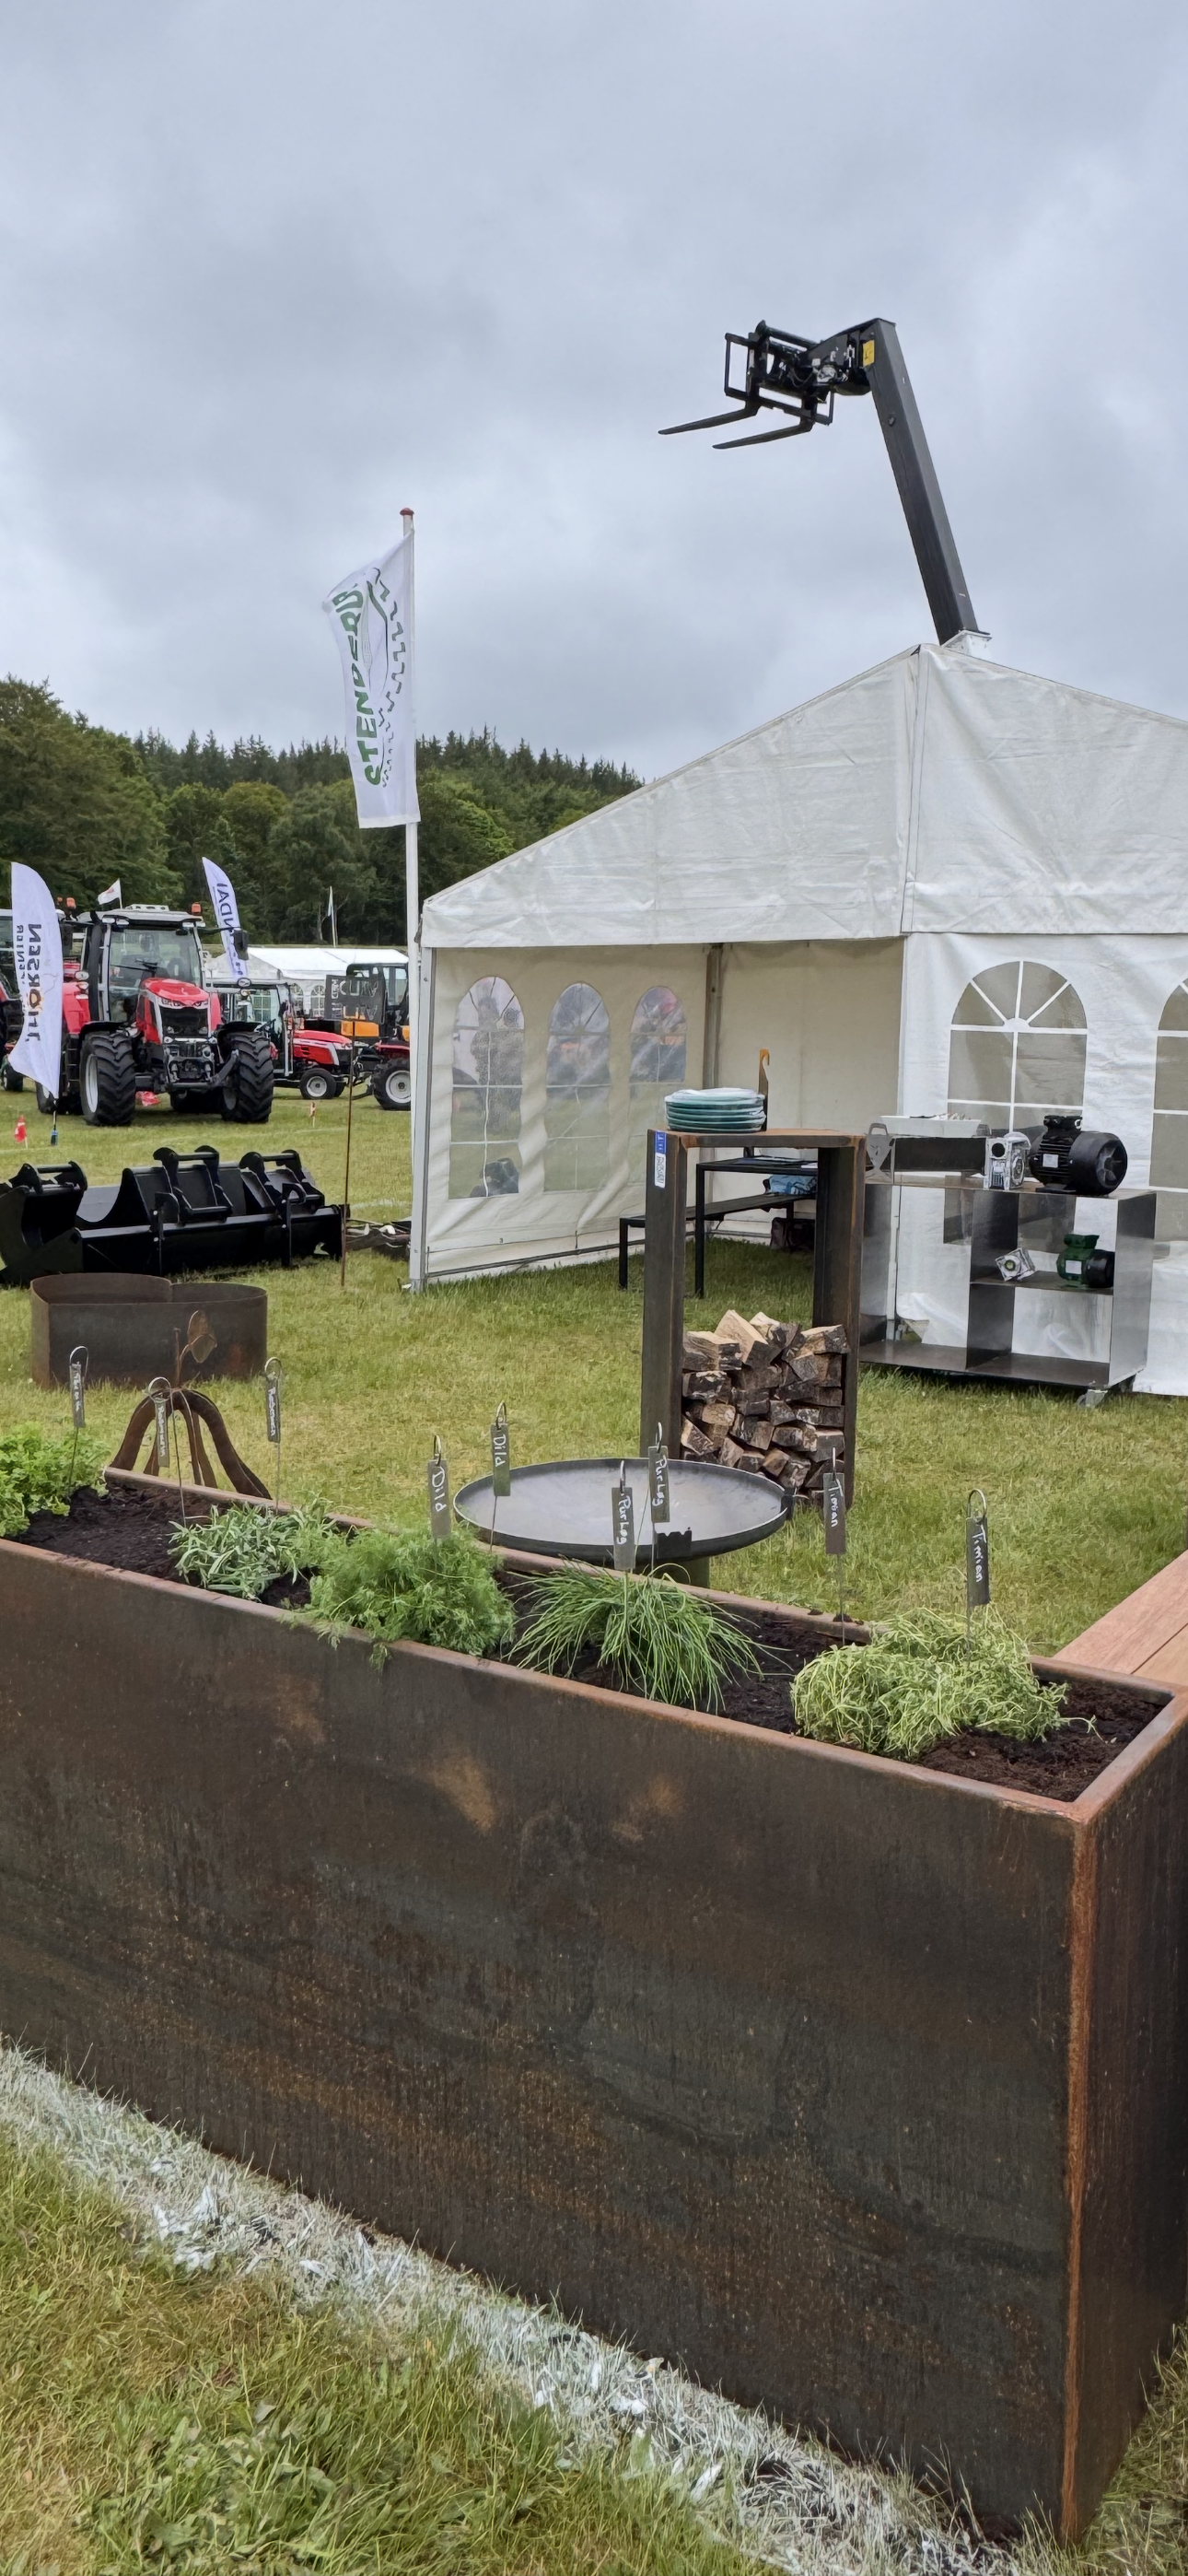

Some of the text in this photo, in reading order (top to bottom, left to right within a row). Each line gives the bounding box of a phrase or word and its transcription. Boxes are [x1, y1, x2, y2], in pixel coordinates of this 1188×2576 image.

[493, 1434, 507, 1468] Dild
[432, 1466, 447, 1512] Dild
[972, 1524, 987, 1583] Timian
